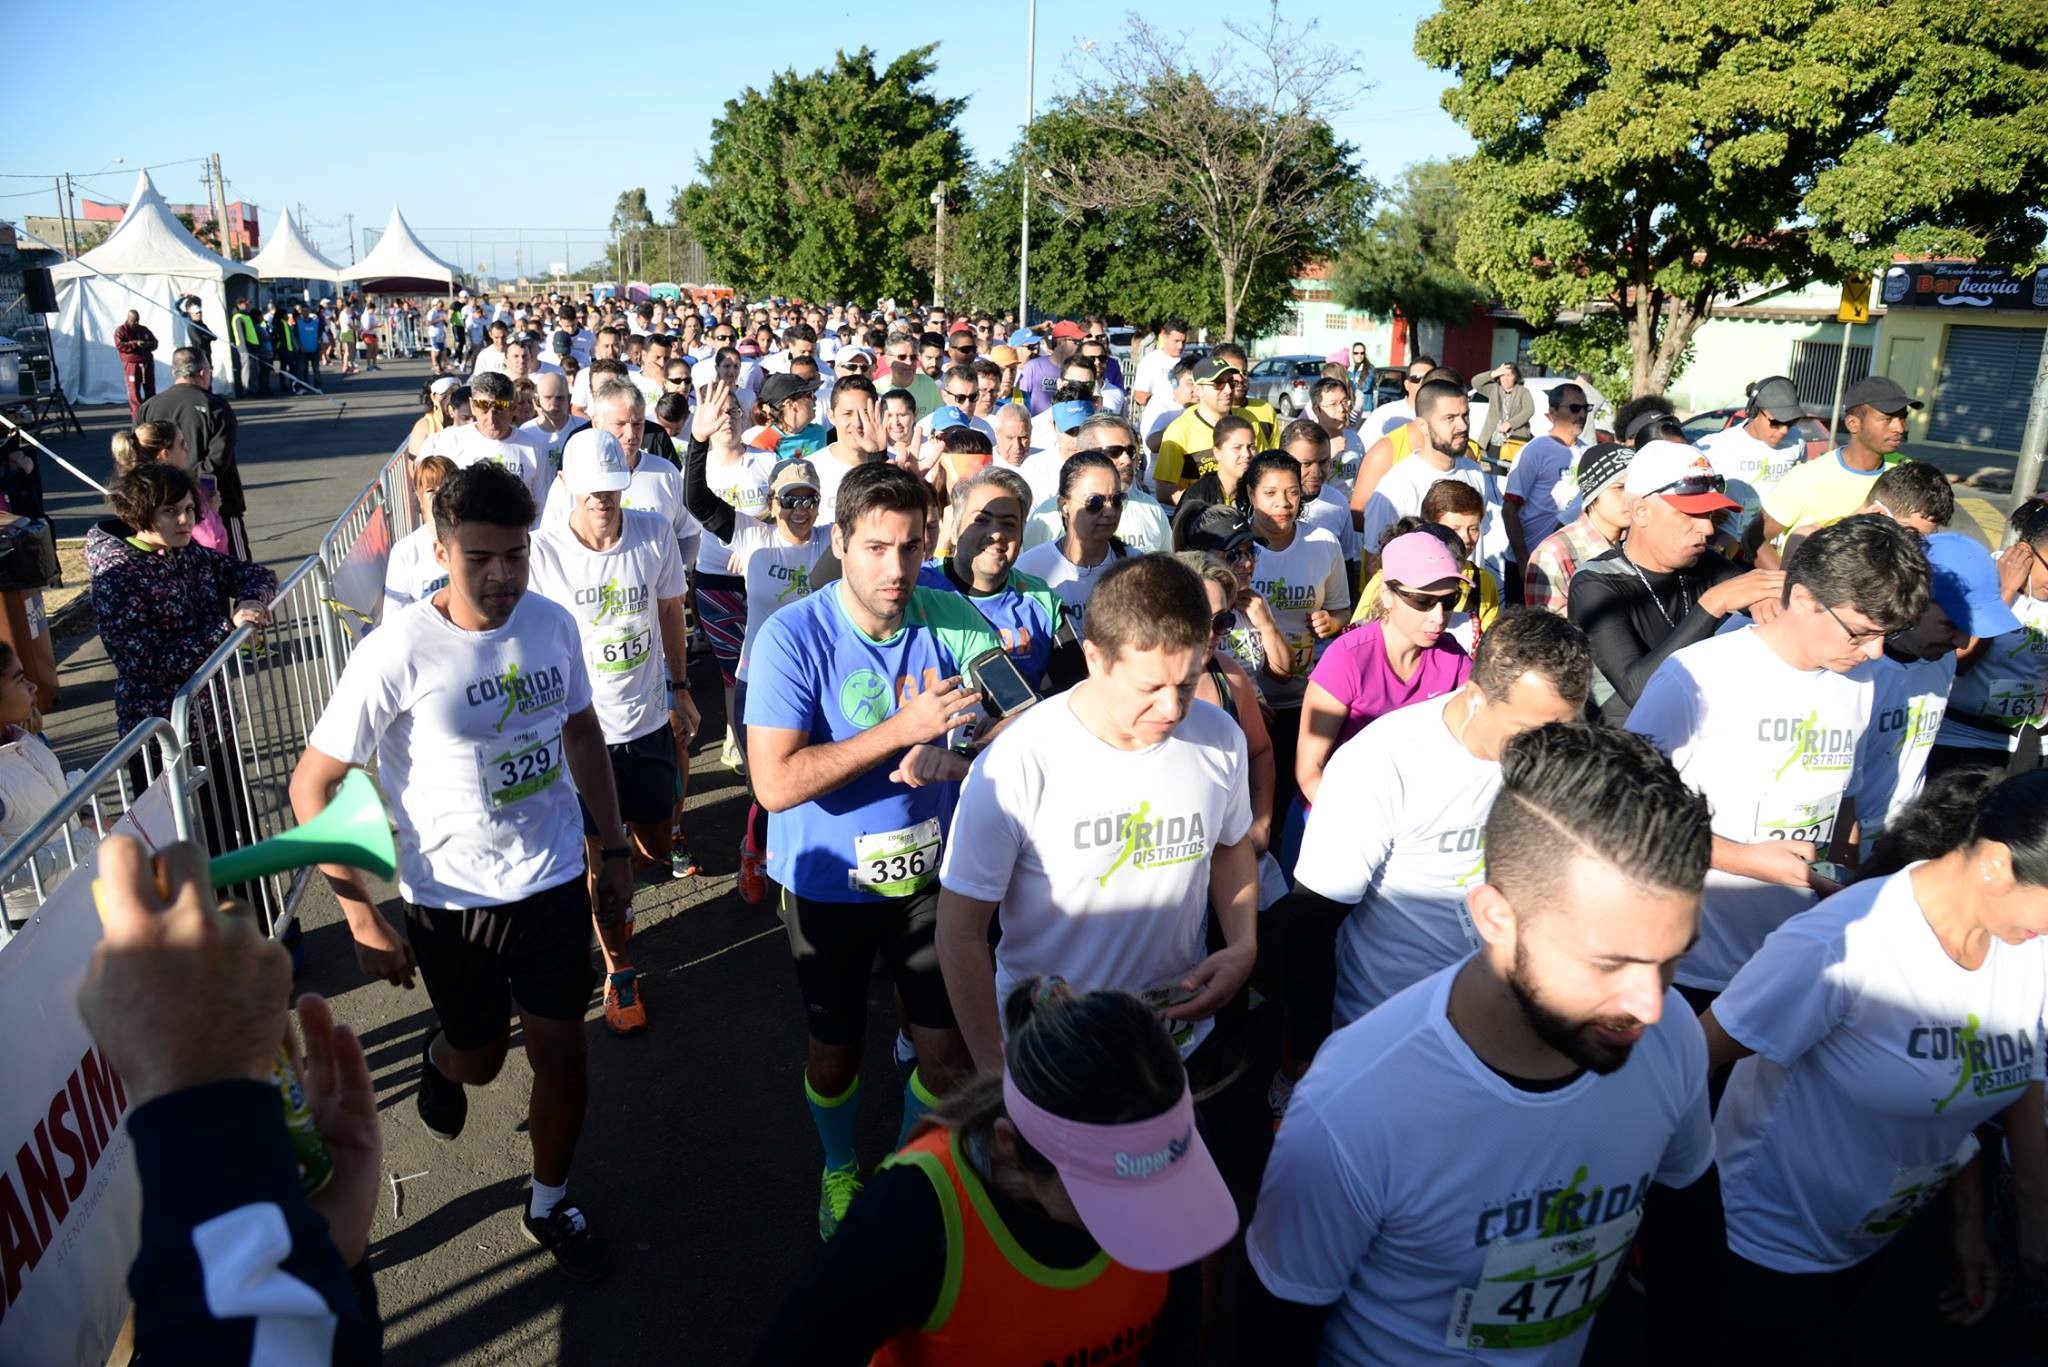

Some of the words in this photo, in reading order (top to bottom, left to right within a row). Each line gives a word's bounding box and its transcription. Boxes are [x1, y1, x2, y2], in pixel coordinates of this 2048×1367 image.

[1916, 274, 2020, 294] Barbearia
[603, 637, 642, 662] 615
[466, 665, 564, 708] CORRIDA
[517, 686, 566, 713] DISTRITOS
[1757, 717, 1853, 754] CORRIDA
[500, 747, 552, 787] 329
[1074, 812, 1205, 850] CORRIDA
[871, 850, 926, 884] 336
[1132, 840, 1205, 865] DISTRITOS
[1906, 1026, 2033, 1074] CORRIDA
[0, 1046, 128, 1326] ANSIM
[1497, 1264, 1599, 1324] 471
